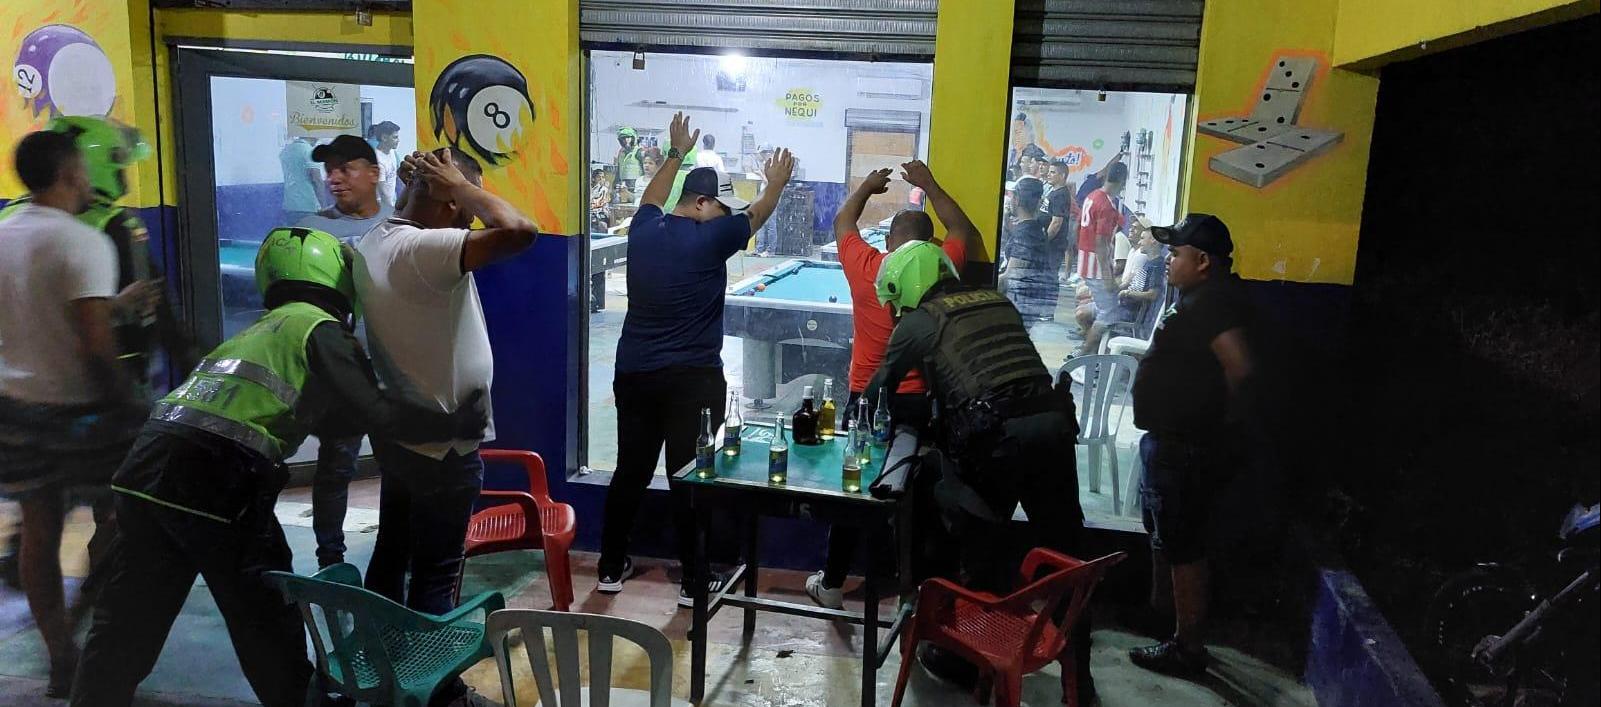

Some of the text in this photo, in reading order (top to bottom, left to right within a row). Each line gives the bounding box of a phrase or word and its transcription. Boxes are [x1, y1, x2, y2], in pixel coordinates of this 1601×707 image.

[18, 69, 35, 94] 12
[785, 93, 820, 103] PAGOS
[289, 112, 356, 127] Bienvenidos
[484, 102, 511, 129] 8
[784, 107, 817, 117] NEQUI
